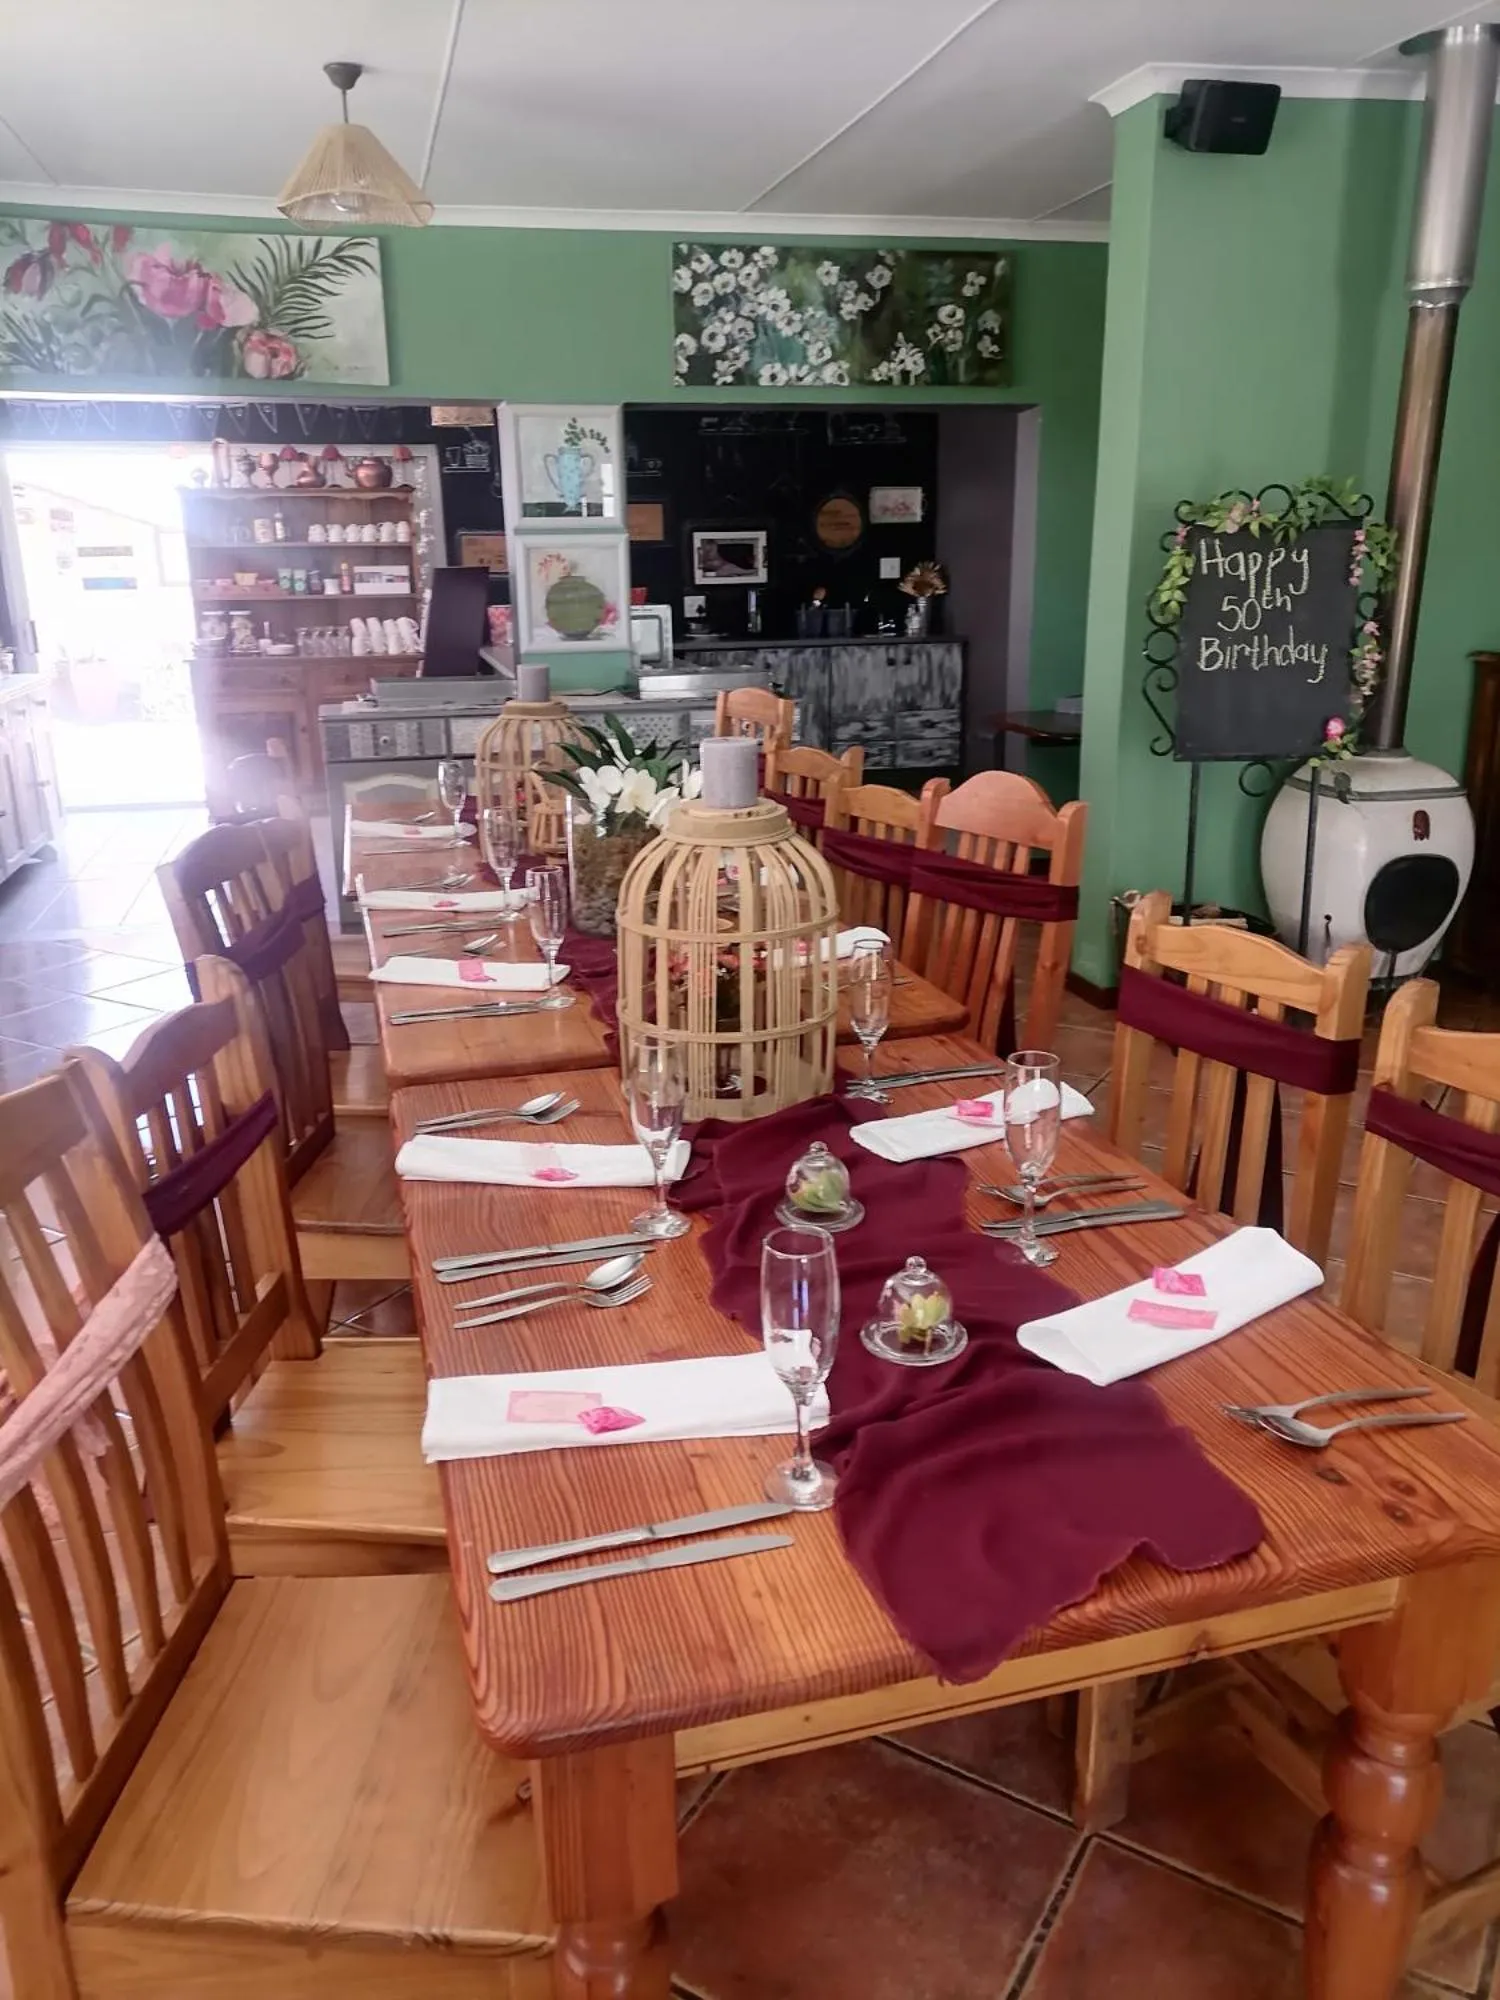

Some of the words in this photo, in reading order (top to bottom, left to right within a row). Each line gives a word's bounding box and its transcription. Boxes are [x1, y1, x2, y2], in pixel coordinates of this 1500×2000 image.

[1199, 538, 1310, 597] Happy
[1217, 588, 1292, 632] 50th
[1197, 626, 1329, 684] Birthday
